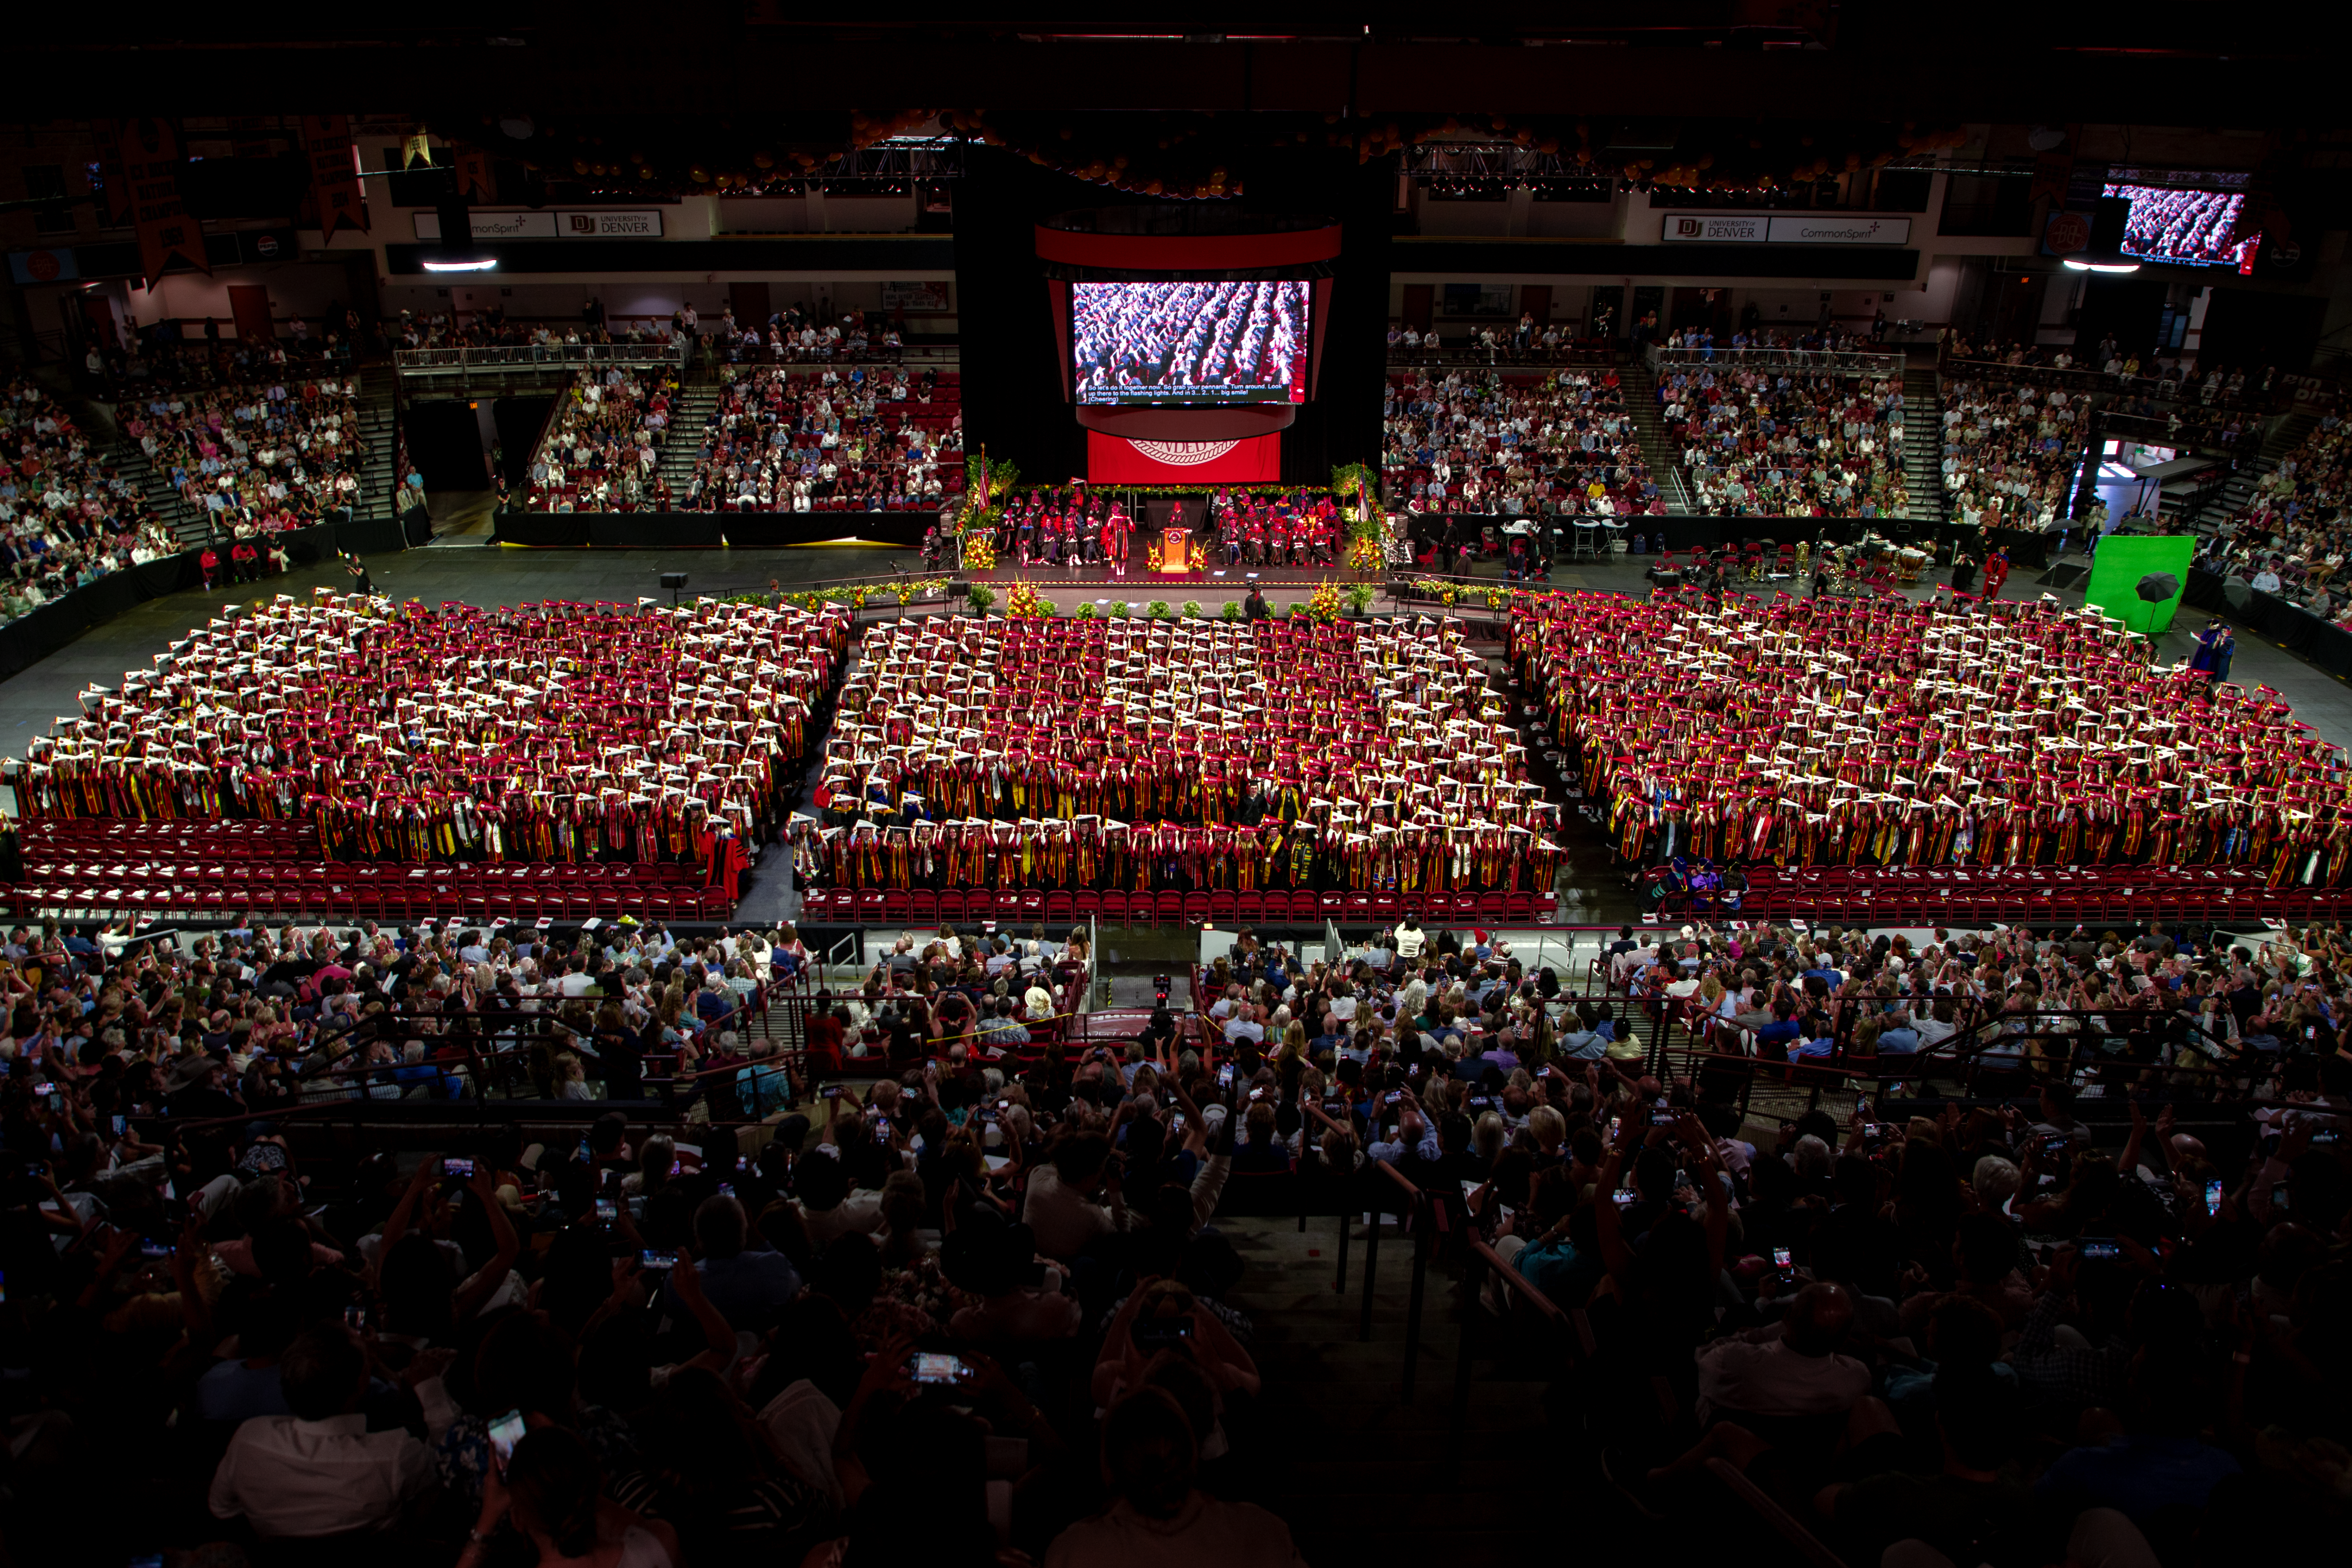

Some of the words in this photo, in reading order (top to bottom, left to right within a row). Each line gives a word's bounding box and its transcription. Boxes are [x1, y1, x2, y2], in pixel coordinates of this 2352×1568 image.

[472, 224, 519, 235] monSpirit
[602, 222, 649, 233] DENVER
[1708, 227, 1754, 238] DENVER
[1801, 228, 1873, 240] CommonSpirit
